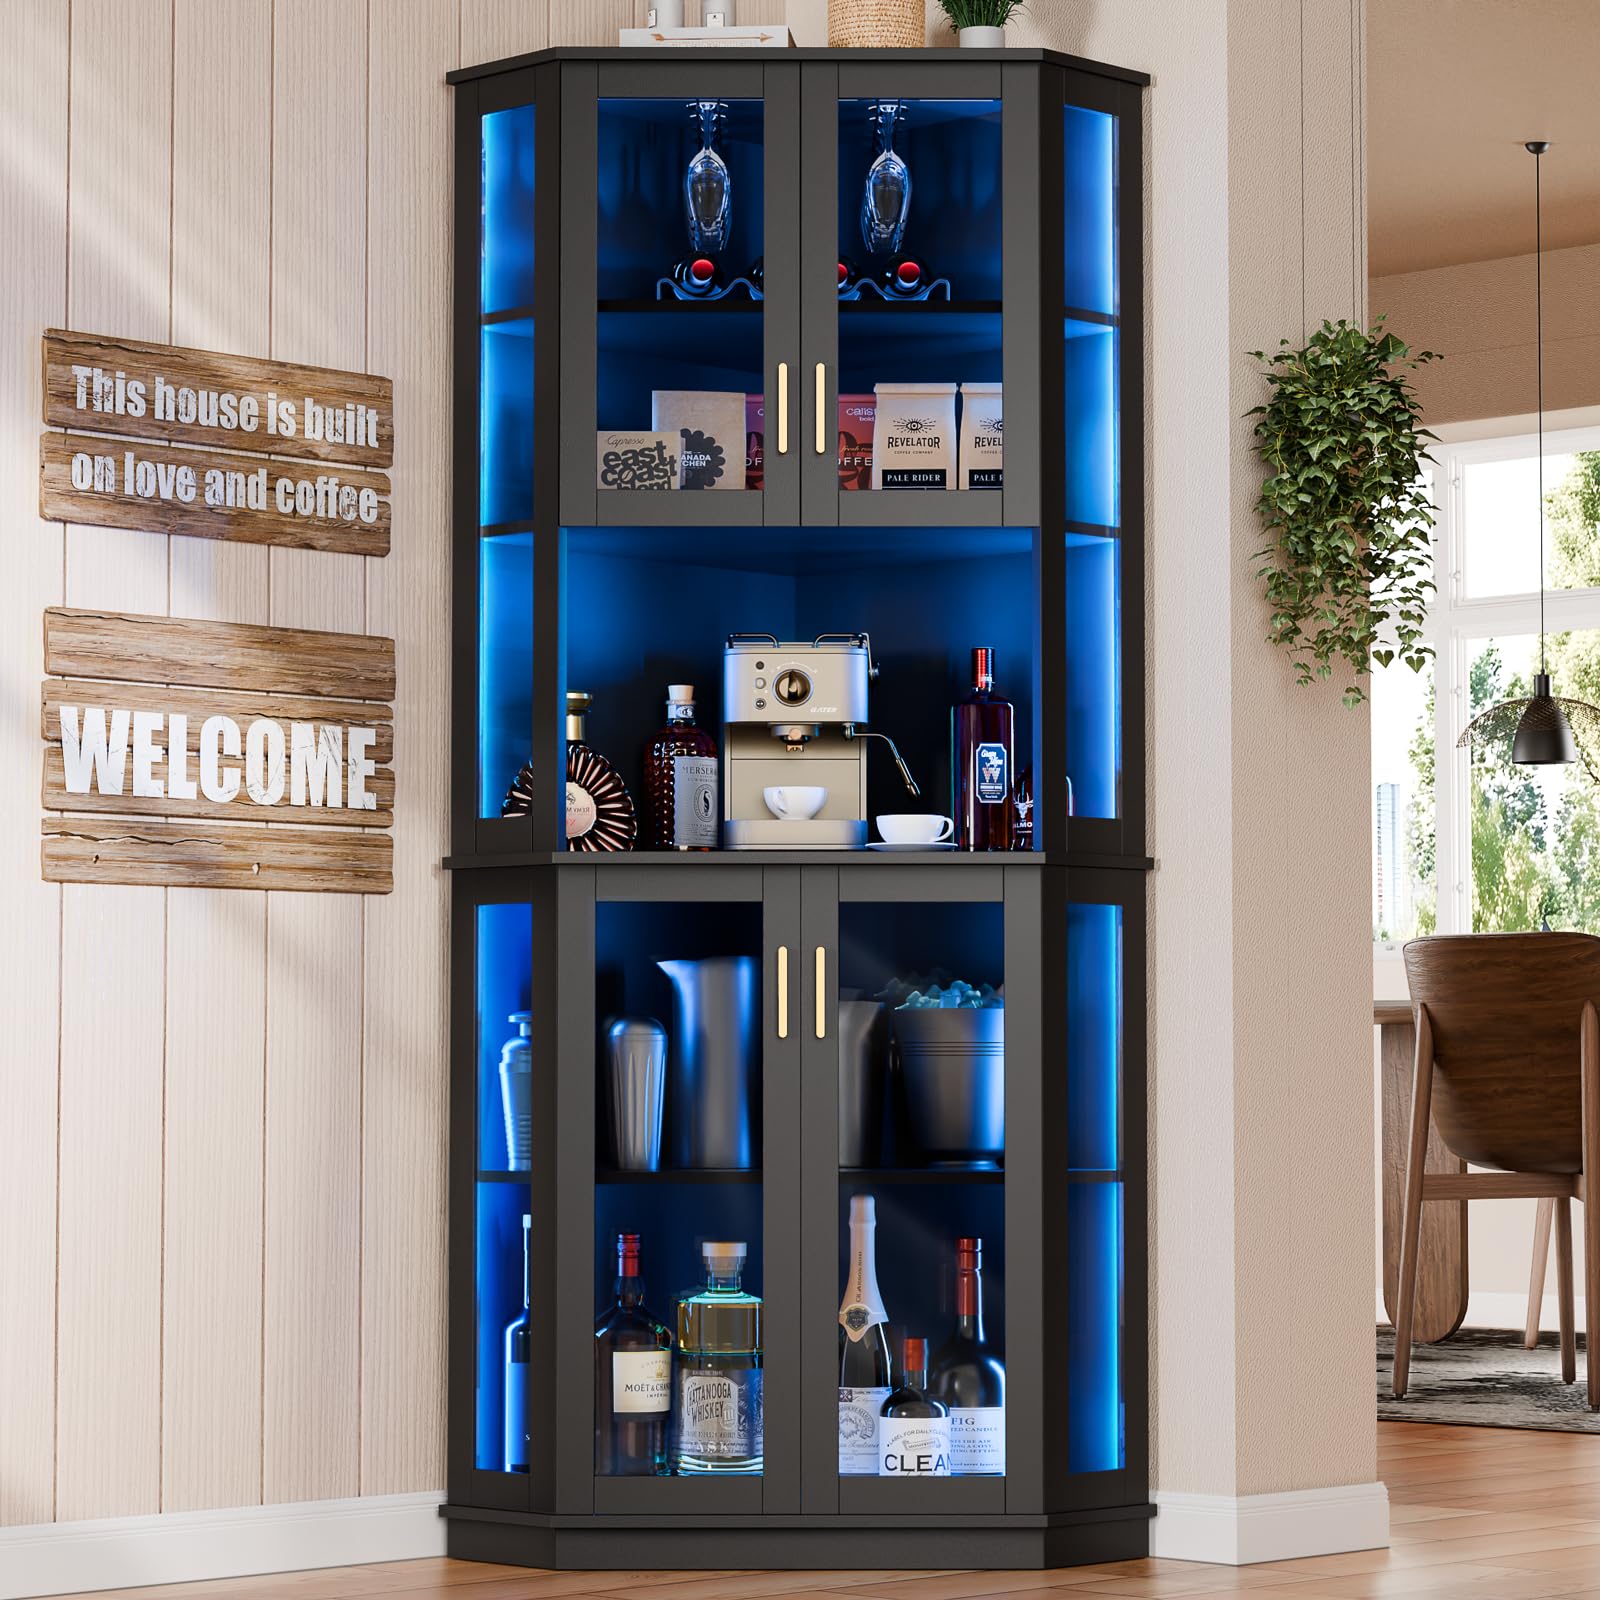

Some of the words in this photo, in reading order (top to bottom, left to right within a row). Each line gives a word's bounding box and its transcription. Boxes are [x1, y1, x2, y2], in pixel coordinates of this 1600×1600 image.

[72, 365, 146, 418] This
[154, 377, 259, 432] house
[267, 392, 297, 437] is
[304, 398, 379, 448] built
[602, 440, 667, 471] east
[607, 434, 645, 448] Capresso
[887, 436, 941, 449] REVELATOR
[601, 454, 677, 487] coast
[887, 473, 909, 481] PALE
[912, 473, 941, 481] RIDER
[974, 473, 995, 481] PALE
[71, 452, 116, 493] on
[124, 451, 197, 503] love
[204, 468, 267, 511] and
[275, 475, 378, 524] coffee
[59, 705, 377, 810] WELCOME
[691, 1401, 725, 1428] WHISKEY
